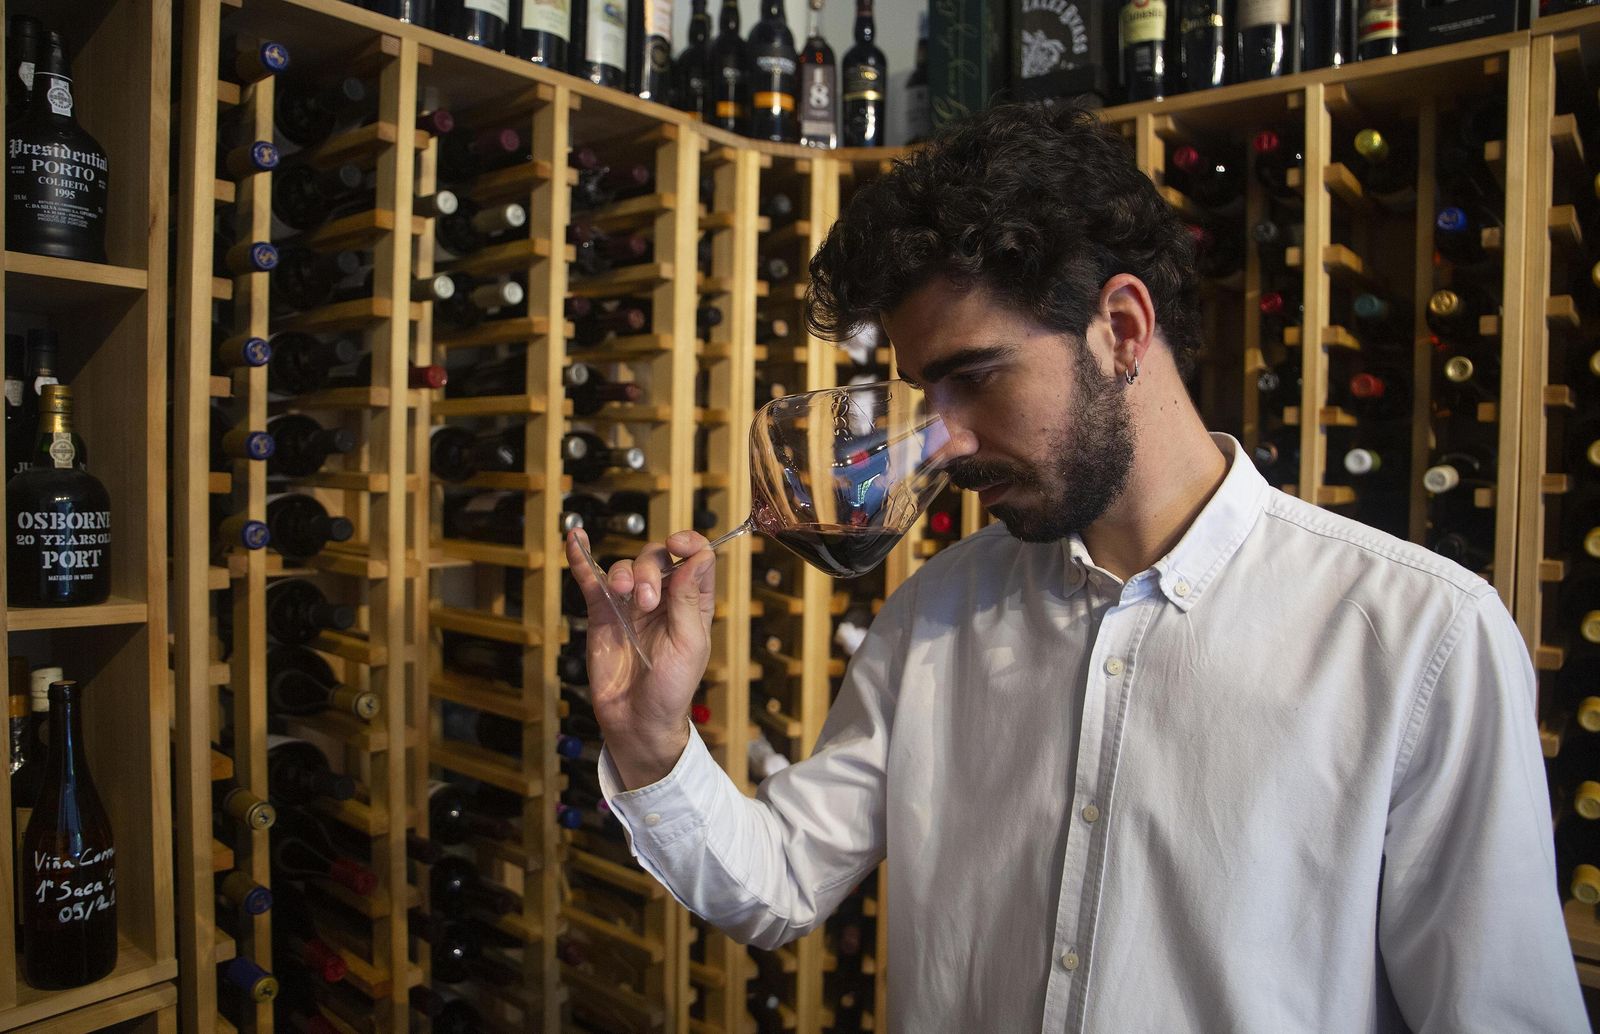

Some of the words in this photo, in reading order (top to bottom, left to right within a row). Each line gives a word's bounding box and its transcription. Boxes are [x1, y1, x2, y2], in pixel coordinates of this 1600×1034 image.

[9, 139, 108, 172] Presidential
[31, 159, 95, 182] PORTO
[38, 176, 89, 192] COLHEITA
[55, 188, 76, 200] 1995
[16, 534, 35, 545] 20
[40, 533, 97, 546] YEARS
[42, 549, 102, 569] PORT
[34, 850, 75, 872] Viña
[55, 880, 104, 901] Saca
